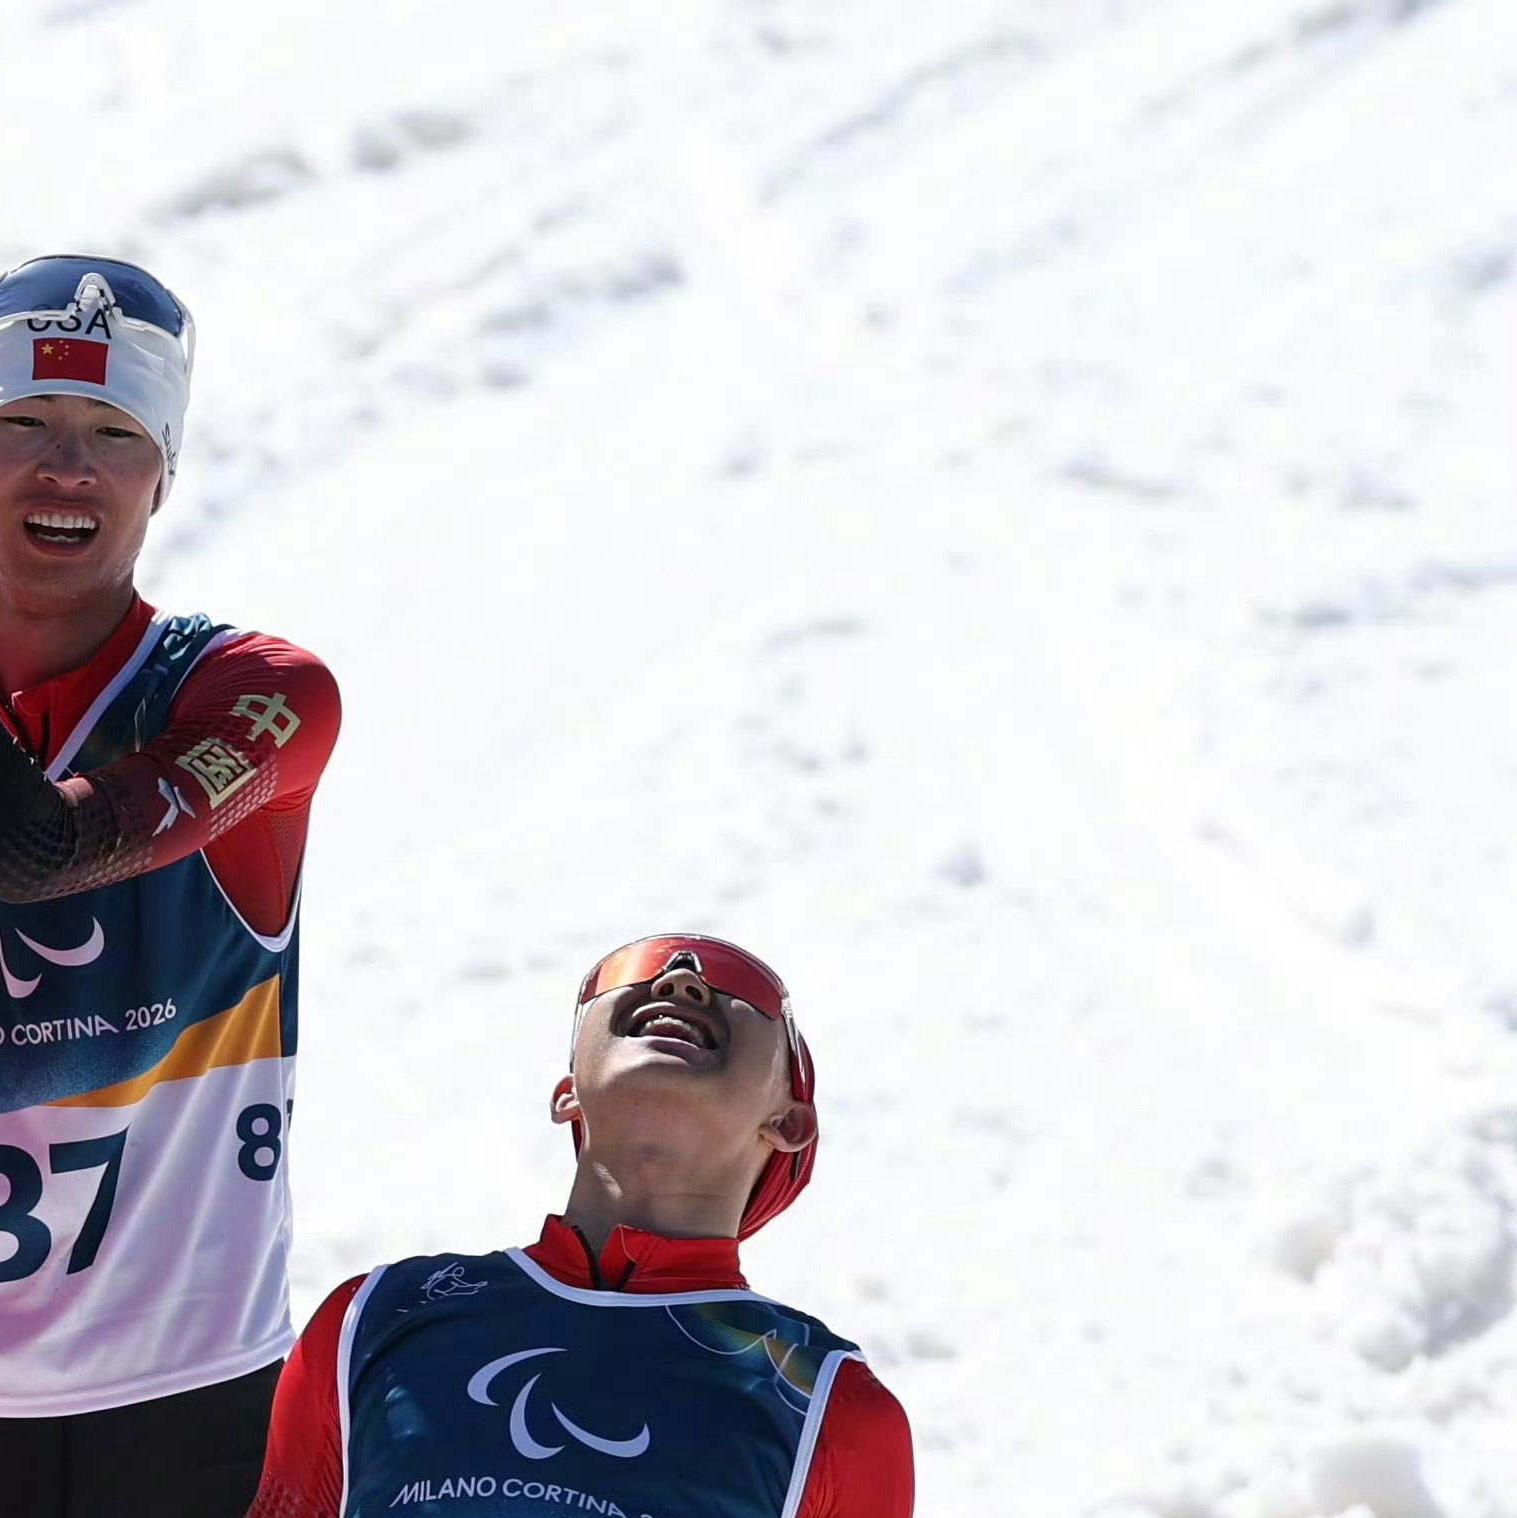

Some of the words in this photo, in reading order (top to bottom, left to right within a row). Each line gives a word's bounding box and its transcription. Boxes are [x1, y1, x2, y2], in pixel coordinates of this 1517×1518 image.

[11, 1014, 119, 1046] CORTINA
[125, 998, 178, 1033] 2026
[235, 1099, 293, 1182] 8
[389, 1476, 496, 1509] MILANO
